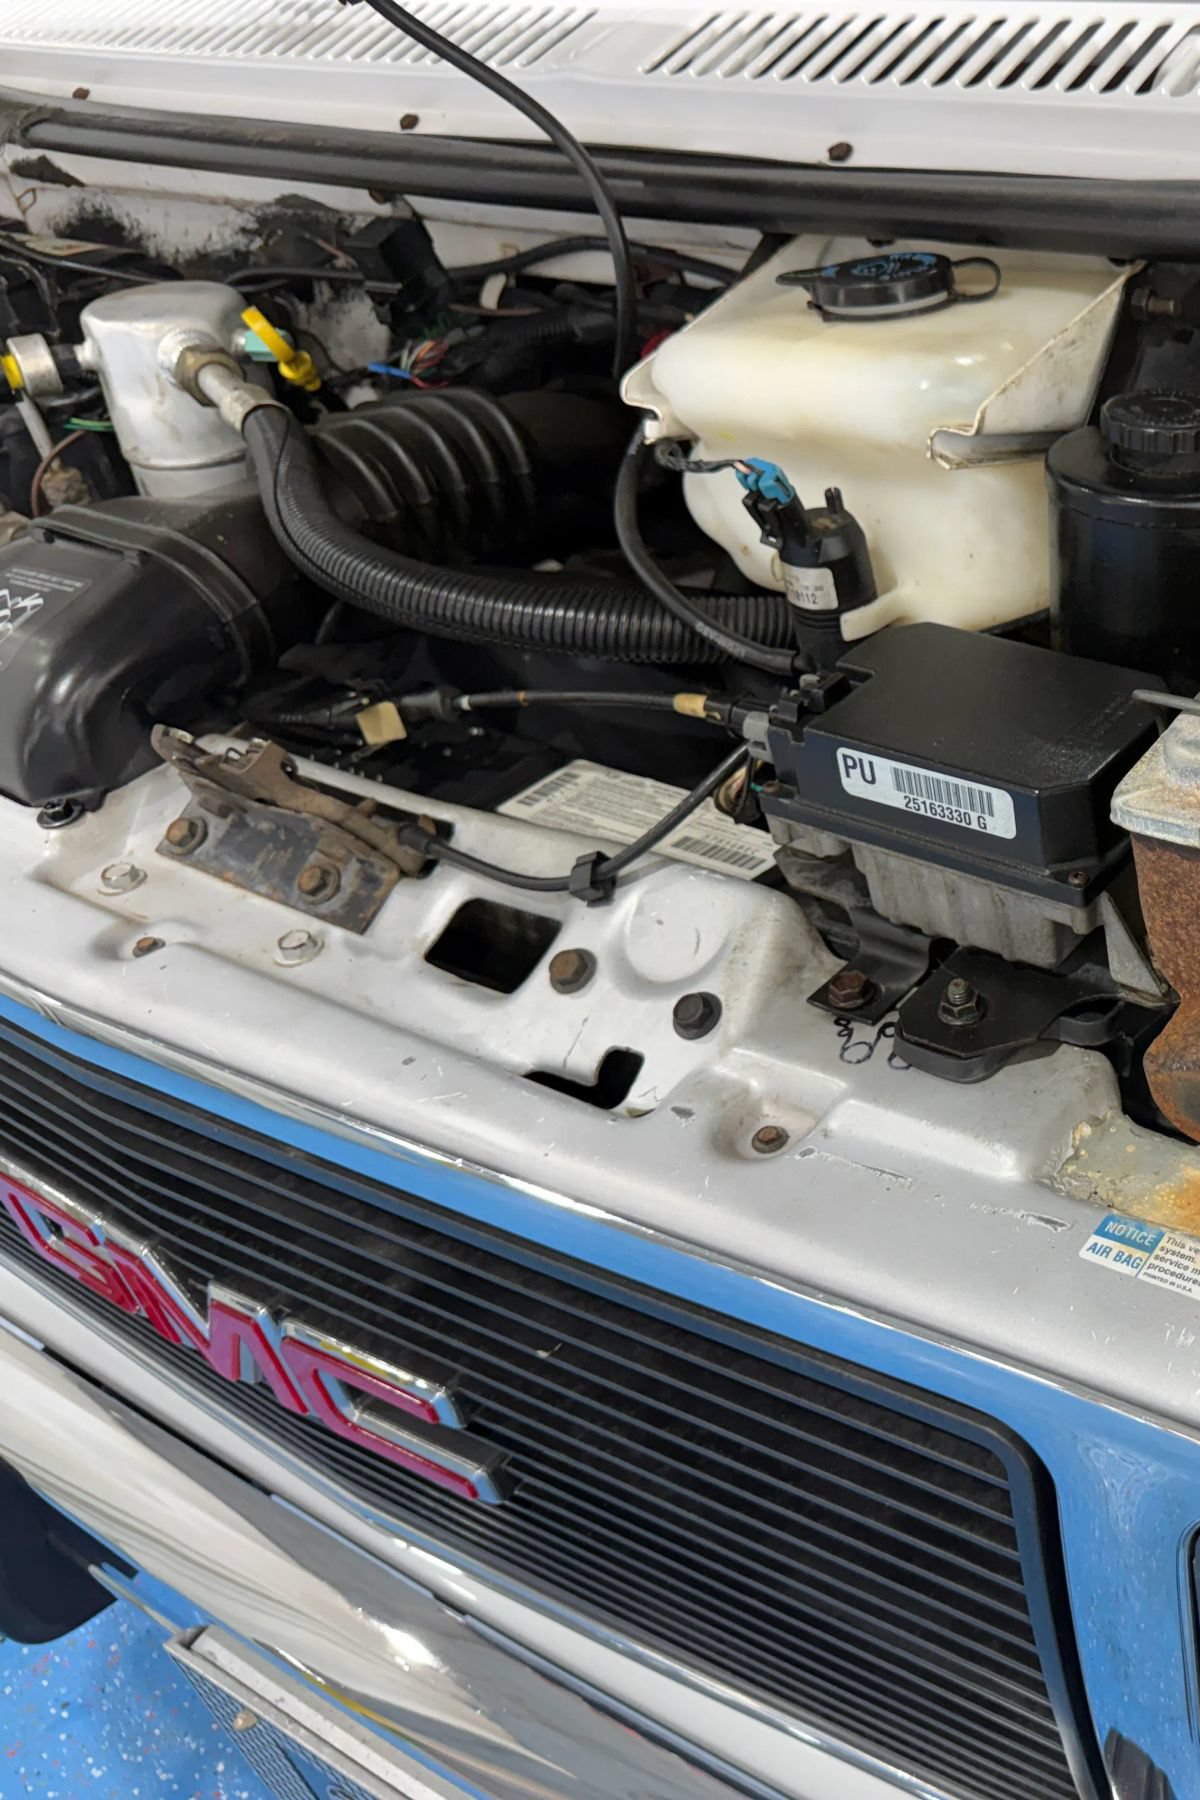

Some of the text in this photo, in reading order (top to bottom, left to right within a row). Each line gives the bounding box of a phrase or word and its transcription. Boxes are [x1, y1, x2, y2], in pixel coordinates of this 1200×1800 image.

[841, 753, 877, 785] PU
[904, 795, 988, 831] 25163330 G
[1105, 1219, 1157, 1247] NOTICE
[1167, 1236, 1186, 1249] This
[1086, 1241, 1143, 1271] AIR BAG
[1153, 1253, 1190, 1271] service
[1159, 1245, 1197, 1264] system.
[0, 1155, 500, 1503] GMC
